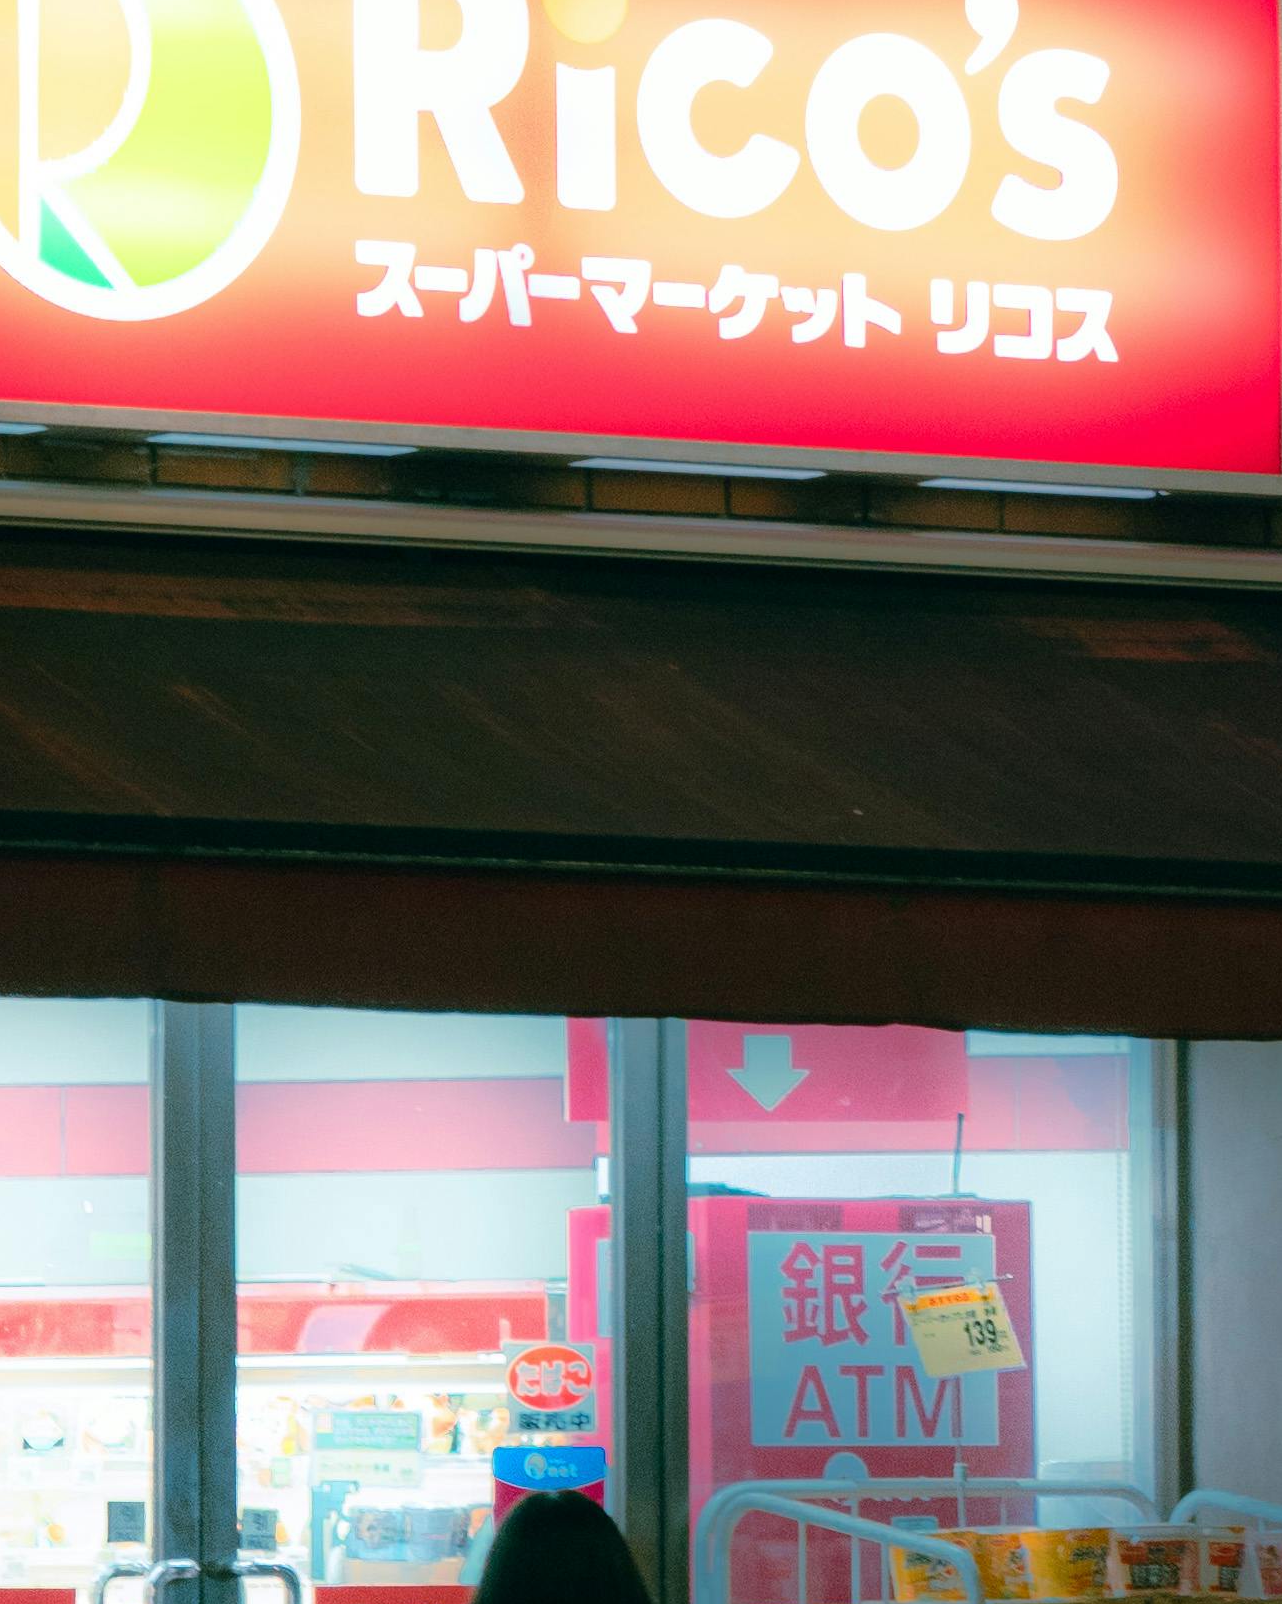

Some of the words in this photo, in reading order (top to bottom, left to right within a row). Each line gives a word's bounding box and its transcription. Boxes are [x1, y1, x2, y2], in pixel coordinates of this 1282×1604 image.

[353, 239, 904, 350] スーパーマーケット
[928, 279, 1121, 364] リコス
[963, 1319, 998, 1347] 139
[515, 1359, 591, 1397] たばこ
[784, 1364, 964, 1440] ATM
